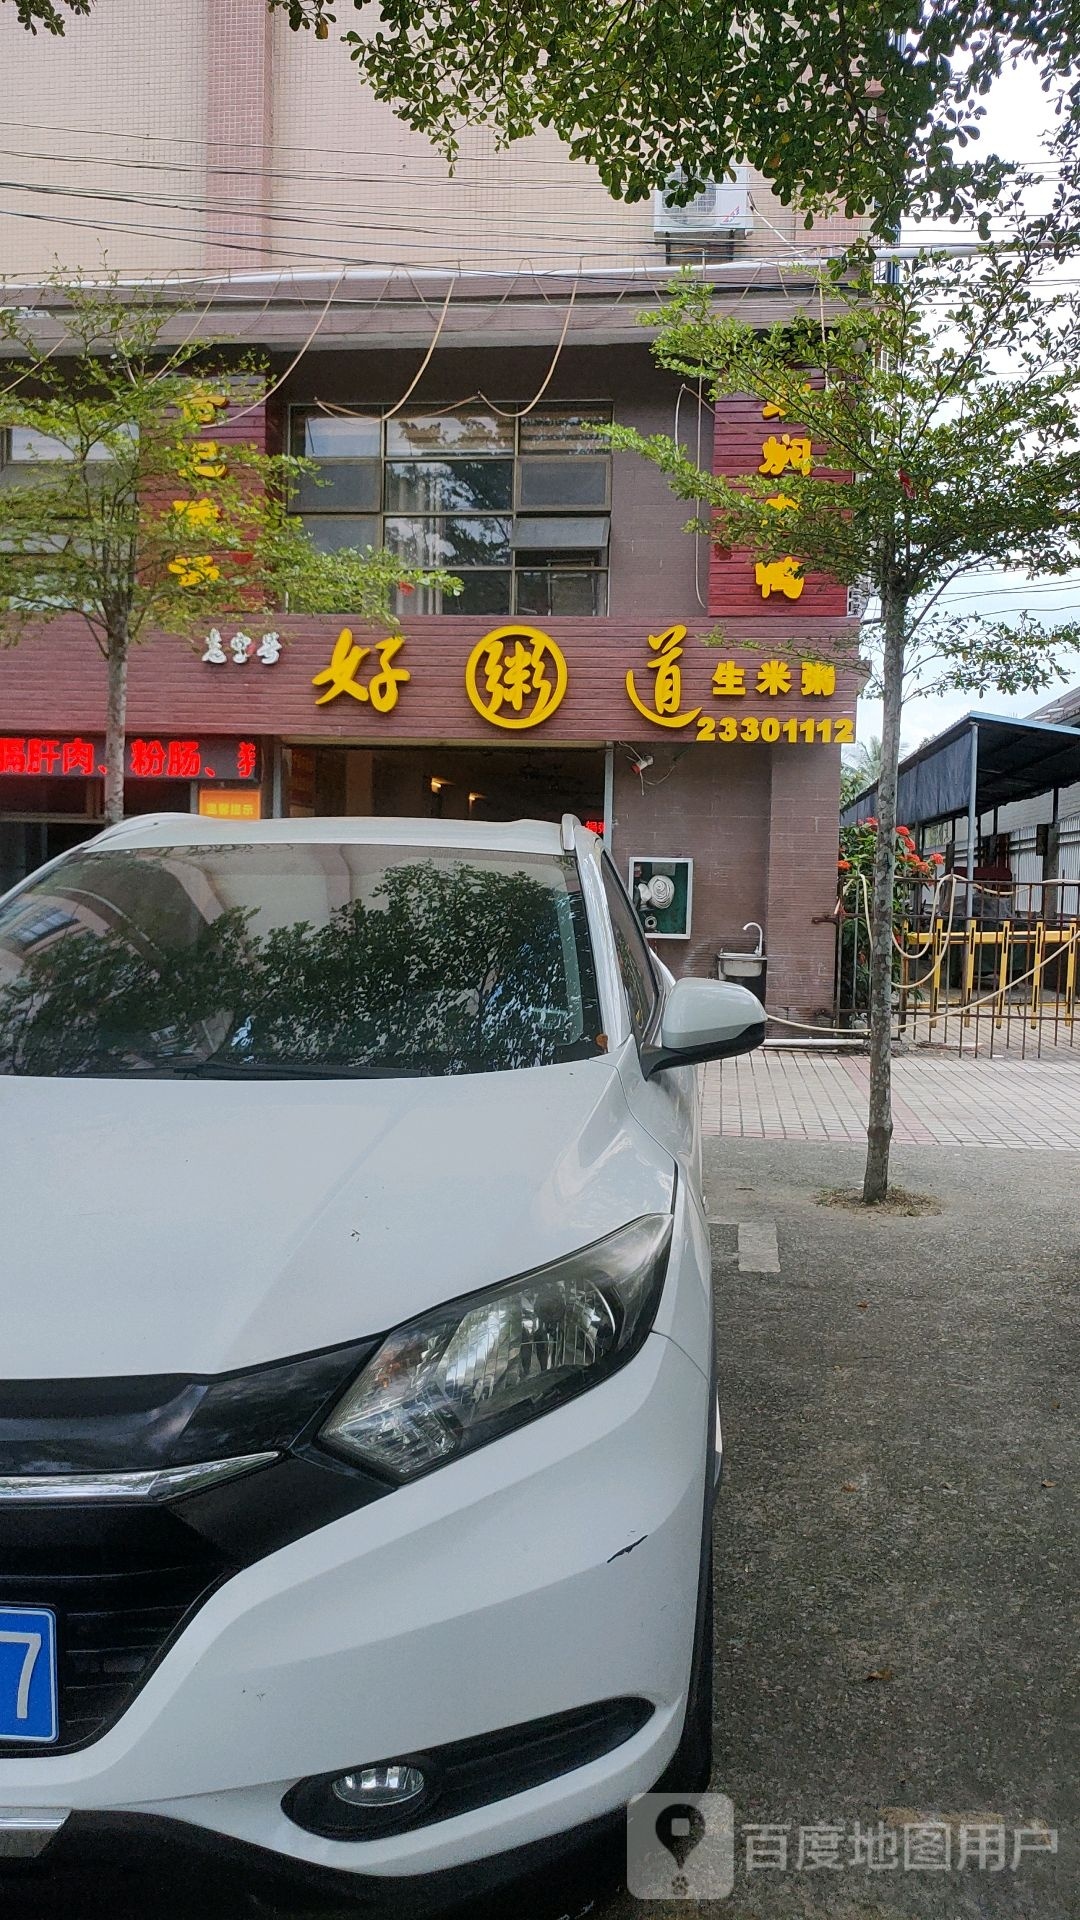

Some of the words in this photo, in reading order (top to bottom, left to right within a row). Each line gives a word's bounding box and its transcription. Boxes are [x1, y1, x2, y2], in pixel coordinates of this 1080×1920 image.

[712, 660, 836, 696] 生米粥
[696, 716, 854, 743] 23301112
